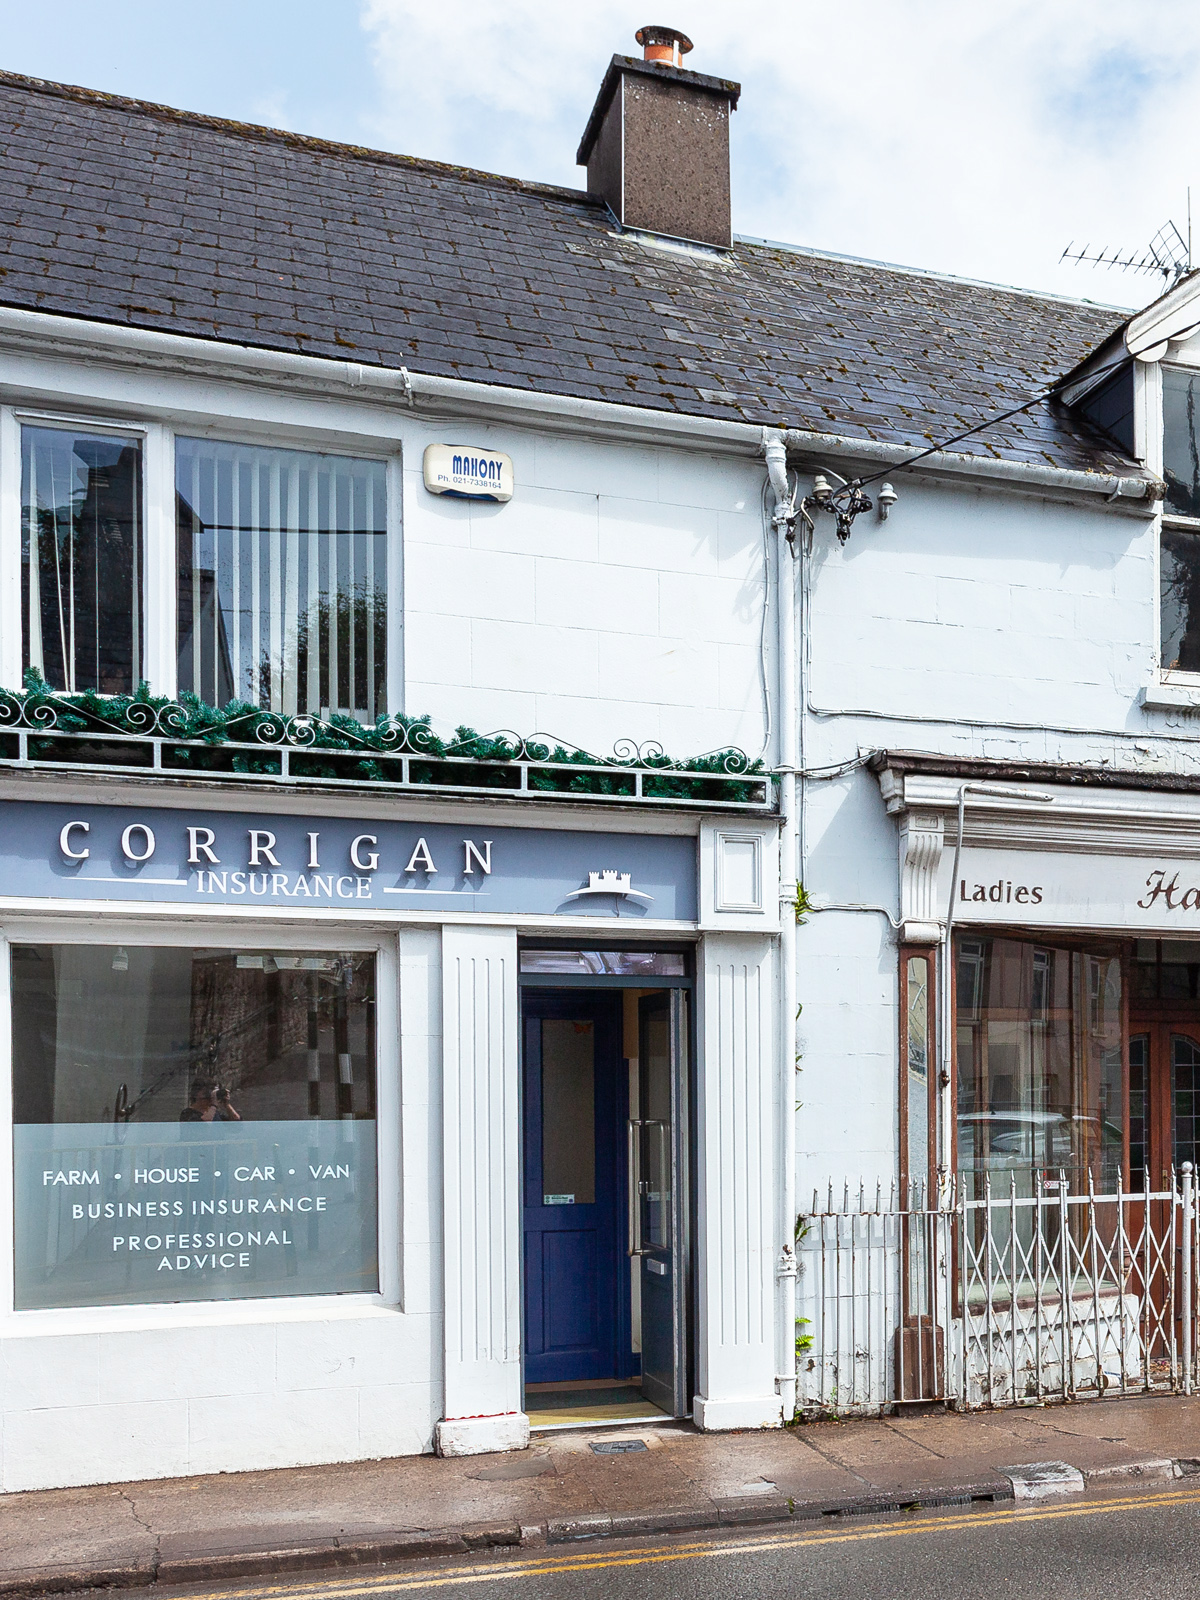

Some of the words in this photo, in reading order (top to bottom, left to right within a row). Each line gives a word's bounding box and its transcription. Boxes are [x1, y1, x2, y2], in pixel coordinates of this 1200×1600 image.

[452, 454, 503, 481] MAHONY
[437, 474, 451, 483] Ph.
[452, 476, 502, 489] 021-7338164
[59, 820, 493, 874] CORRIGAN
[196, 869, 373, 900] INSURANCE
[960, 879, 1043, 904] Ladies
[43, 1169, 100, 1186] FARM
[134, 1167, 200, 1184] HOUSE
[233, 1166, 276, 1182] CAR
[308, 1164, 350, 1179] VAN
[72, 1200, 184, 1219] BUSINESS
[192, 1197, 327, 1216] INSURANCE
[113, 1230, 292, 1251] PROFESSIONAL
[157, 1252, 250, 1271] ADVICE
